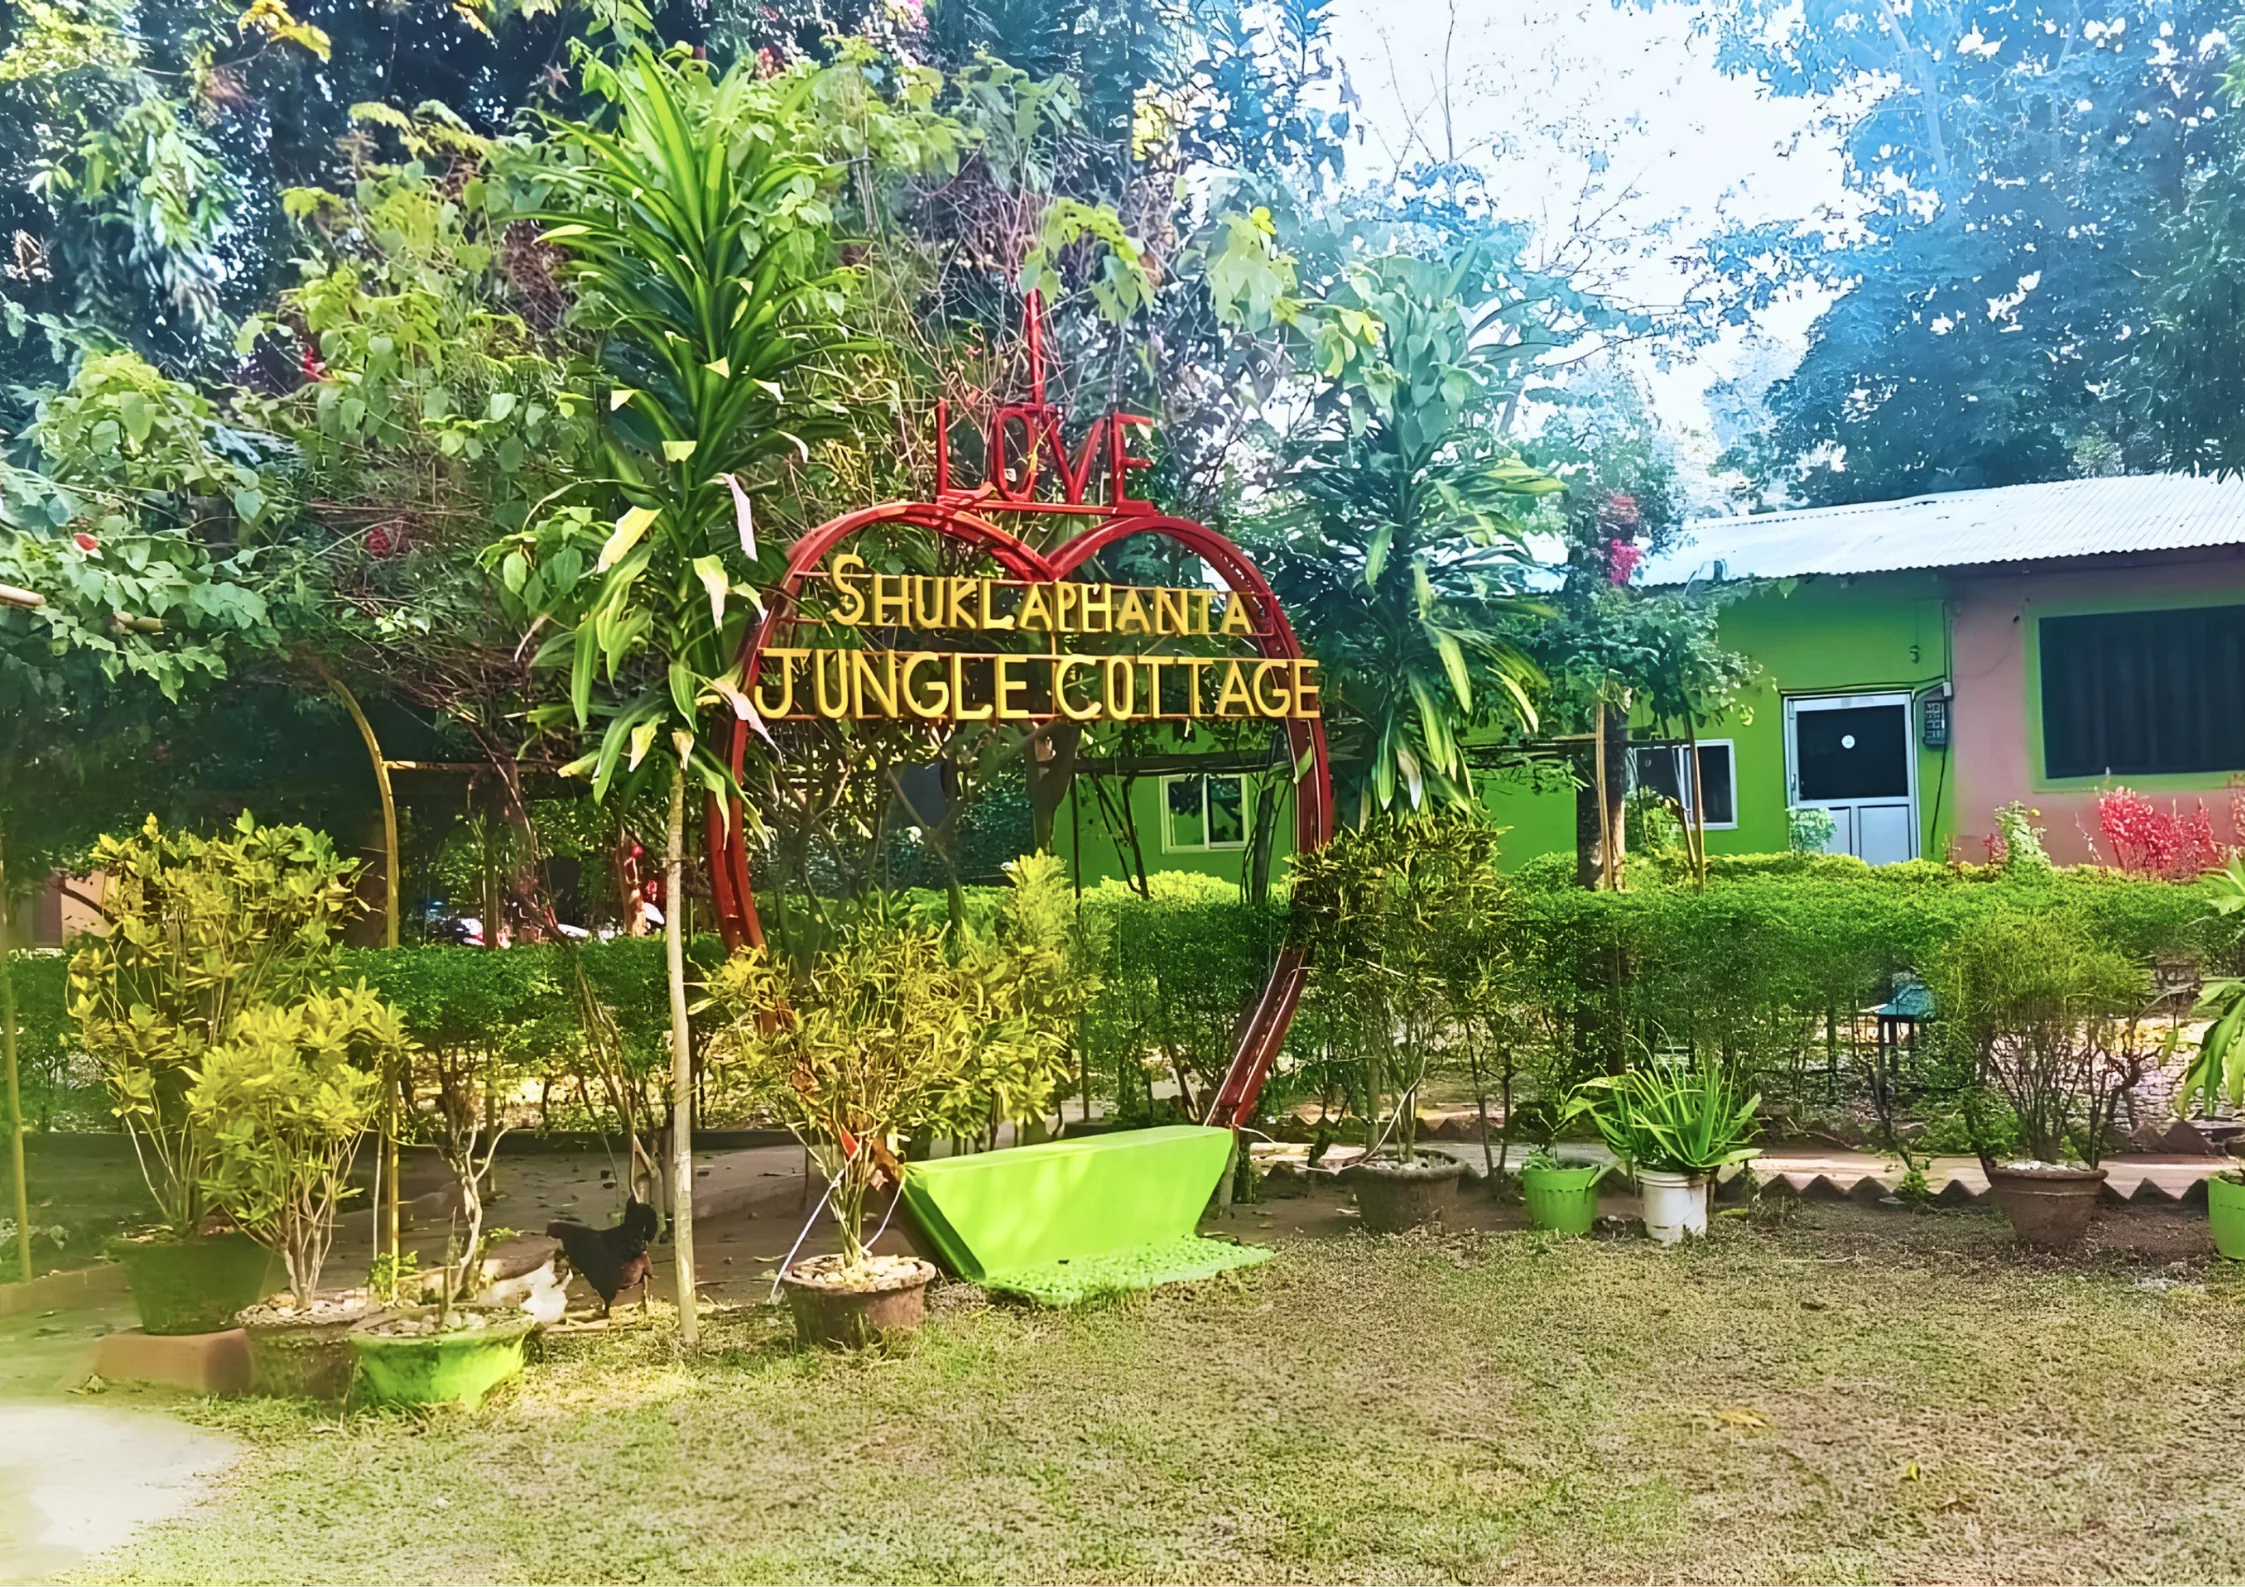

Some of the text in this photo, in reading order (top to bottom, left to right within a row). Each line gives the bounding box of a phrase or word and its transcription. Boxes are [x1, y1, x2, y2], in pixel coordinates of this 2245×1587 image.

[936, 397, 1156, 510] LOVE
[829, 553, 1253, 635] SHUKLAPHANTA
[754, 647, 1321, 720] JUNGLE COTTAGE
